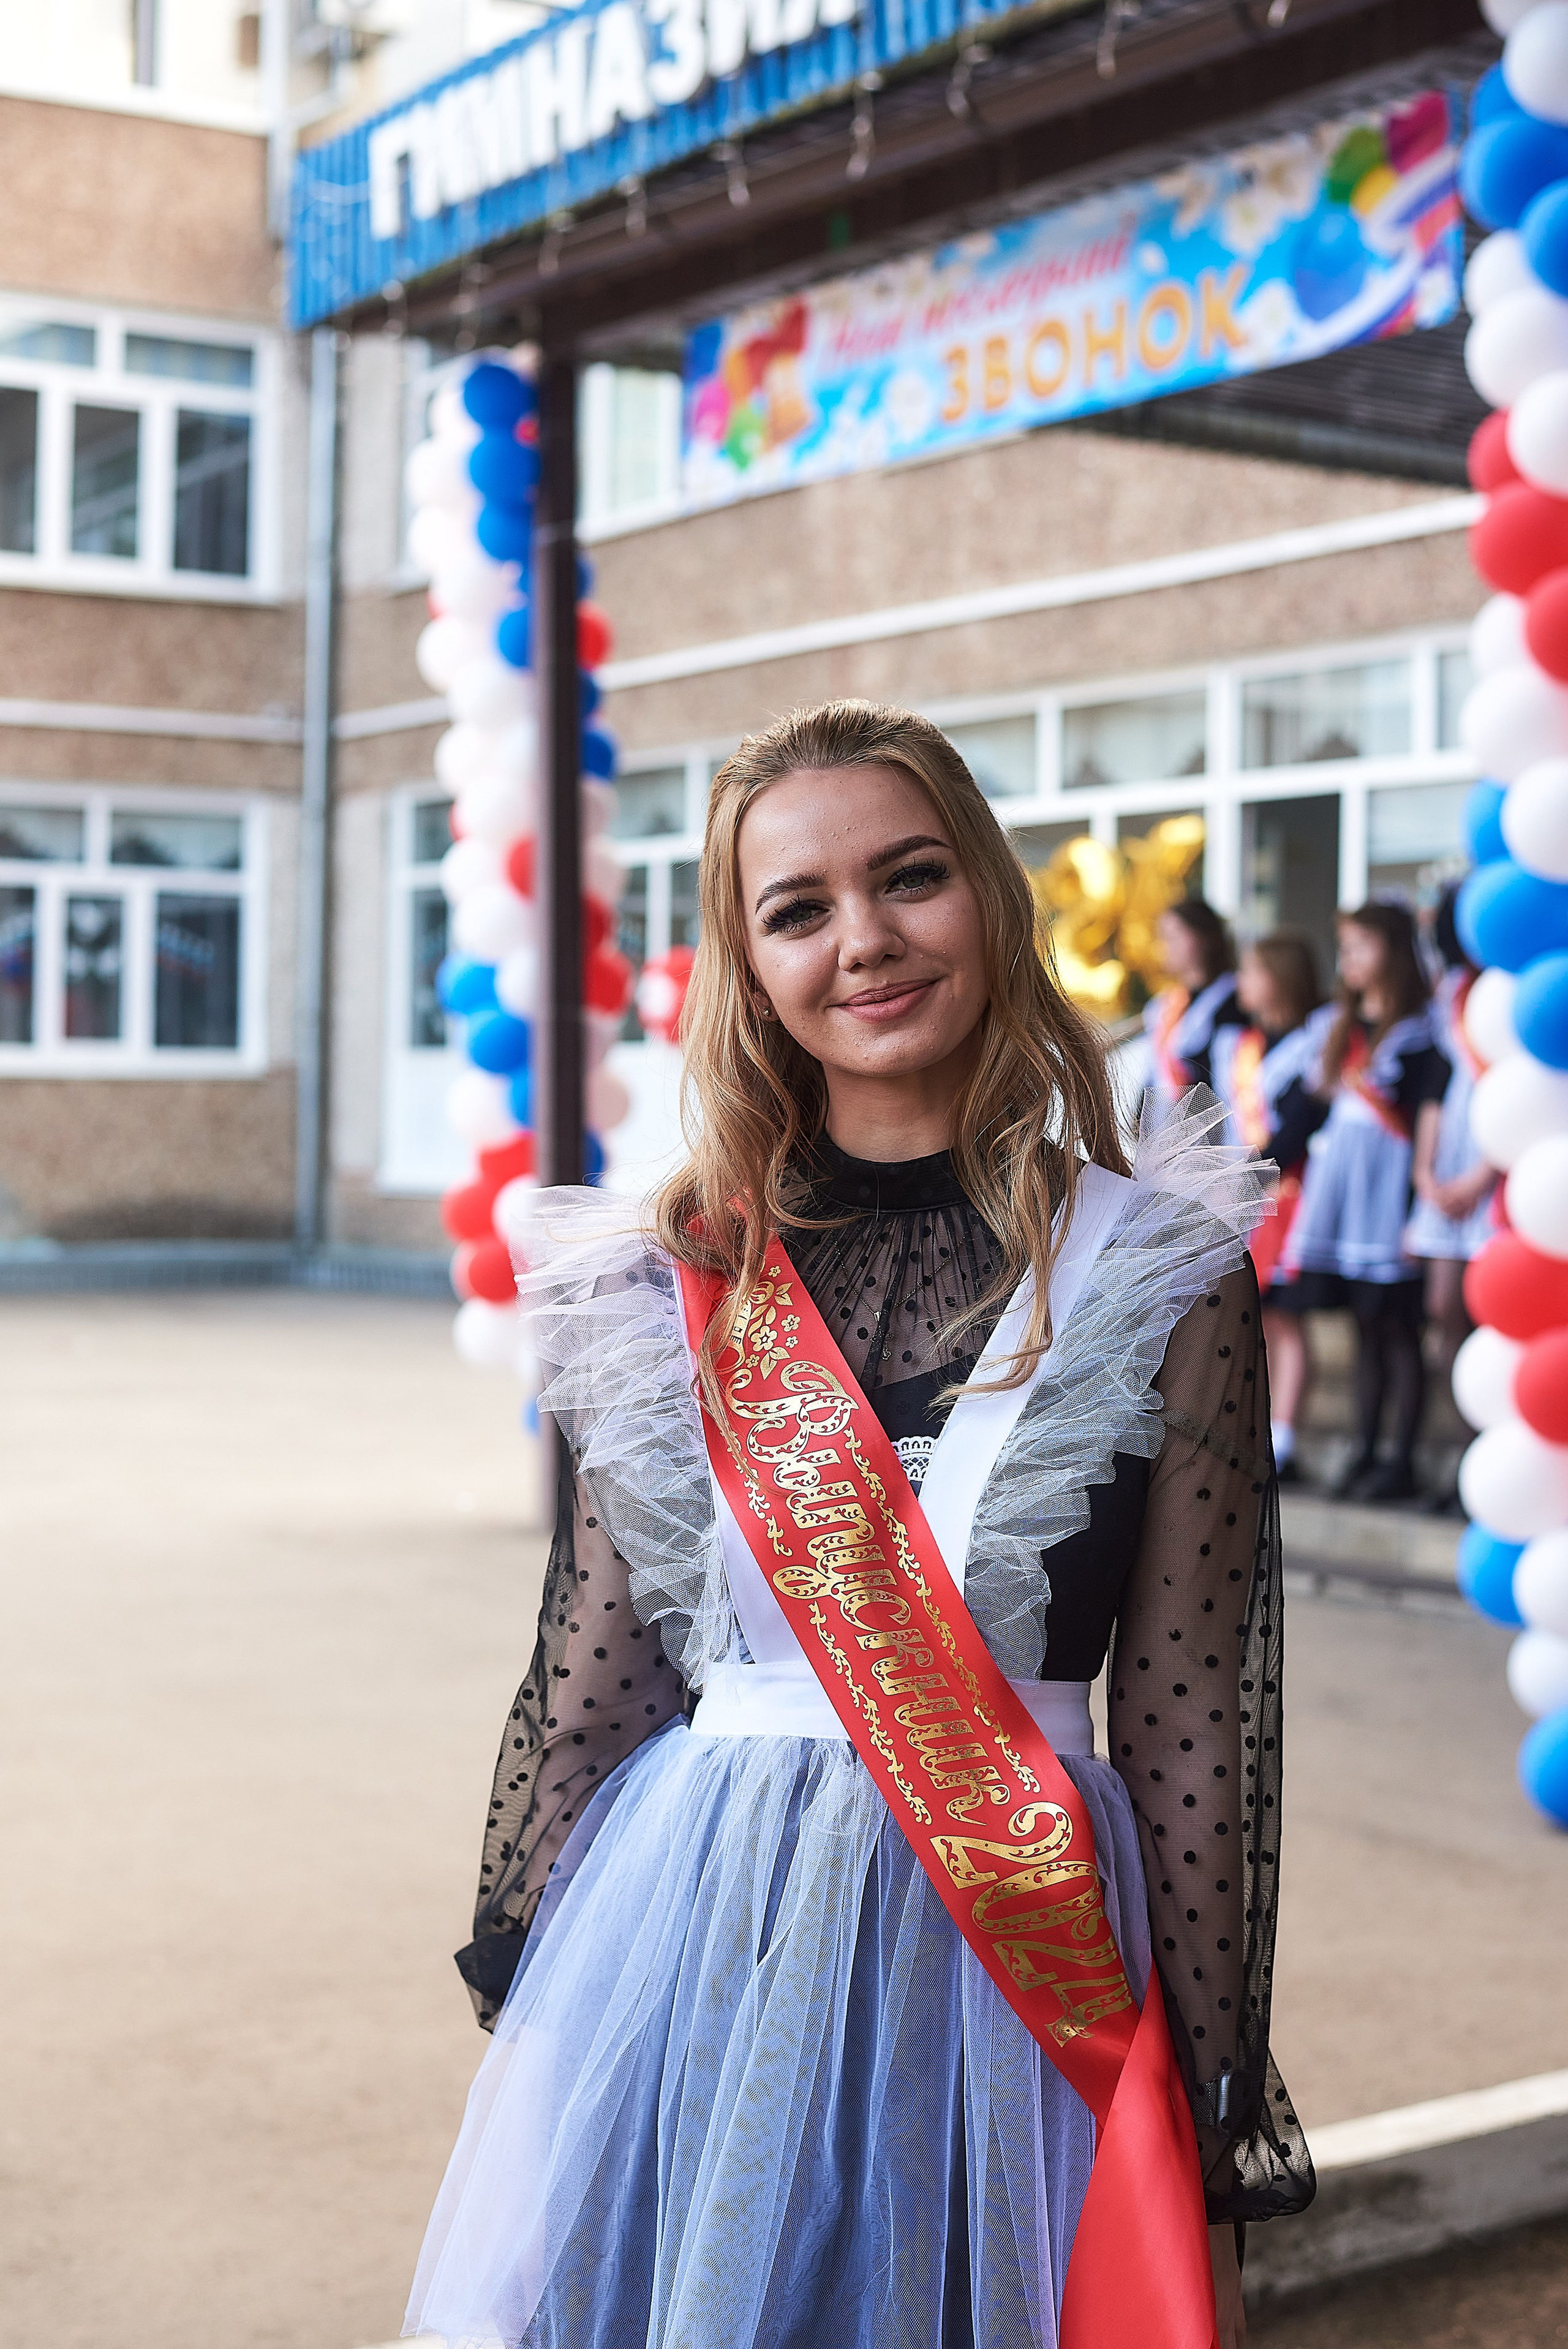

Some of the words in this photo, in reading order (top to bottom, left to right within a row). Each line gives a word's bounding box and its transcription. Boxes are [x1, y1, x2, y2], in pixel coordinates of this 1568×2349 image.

[369, 0, 854, 239] ГИМНАЗИ
[940, 262, 1251, 423] ЗВОНОК
[725, 1360, 1012, 1826] Выпускник
[929, 1801, 1133, 2048] 2024
